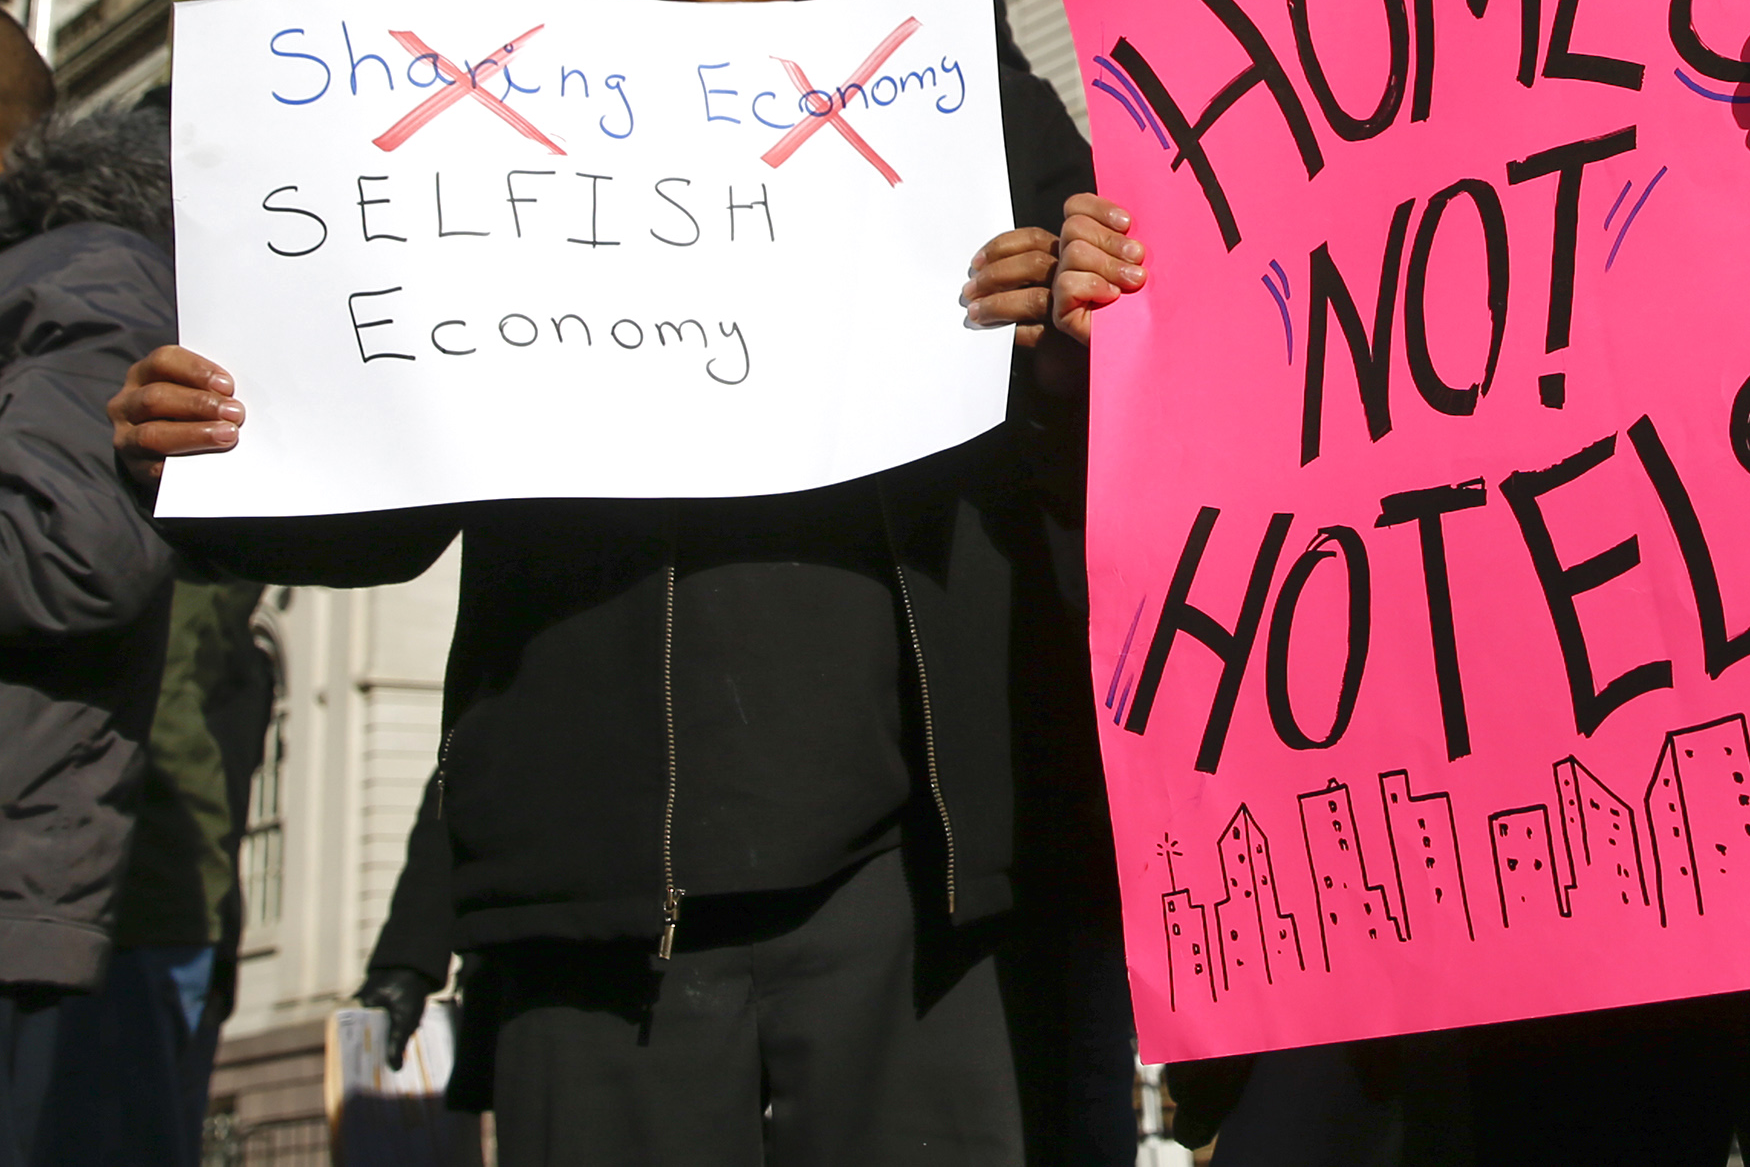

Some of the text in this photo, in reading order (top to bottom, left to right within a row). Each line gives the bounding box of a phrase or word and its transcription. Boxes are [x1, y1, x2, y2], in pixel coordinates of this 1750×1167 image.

[269, 21, 966, 139] Sharing Economy
[262, 169, 775, 257] SELFISH
[348, 286, 750, 385] Economy
